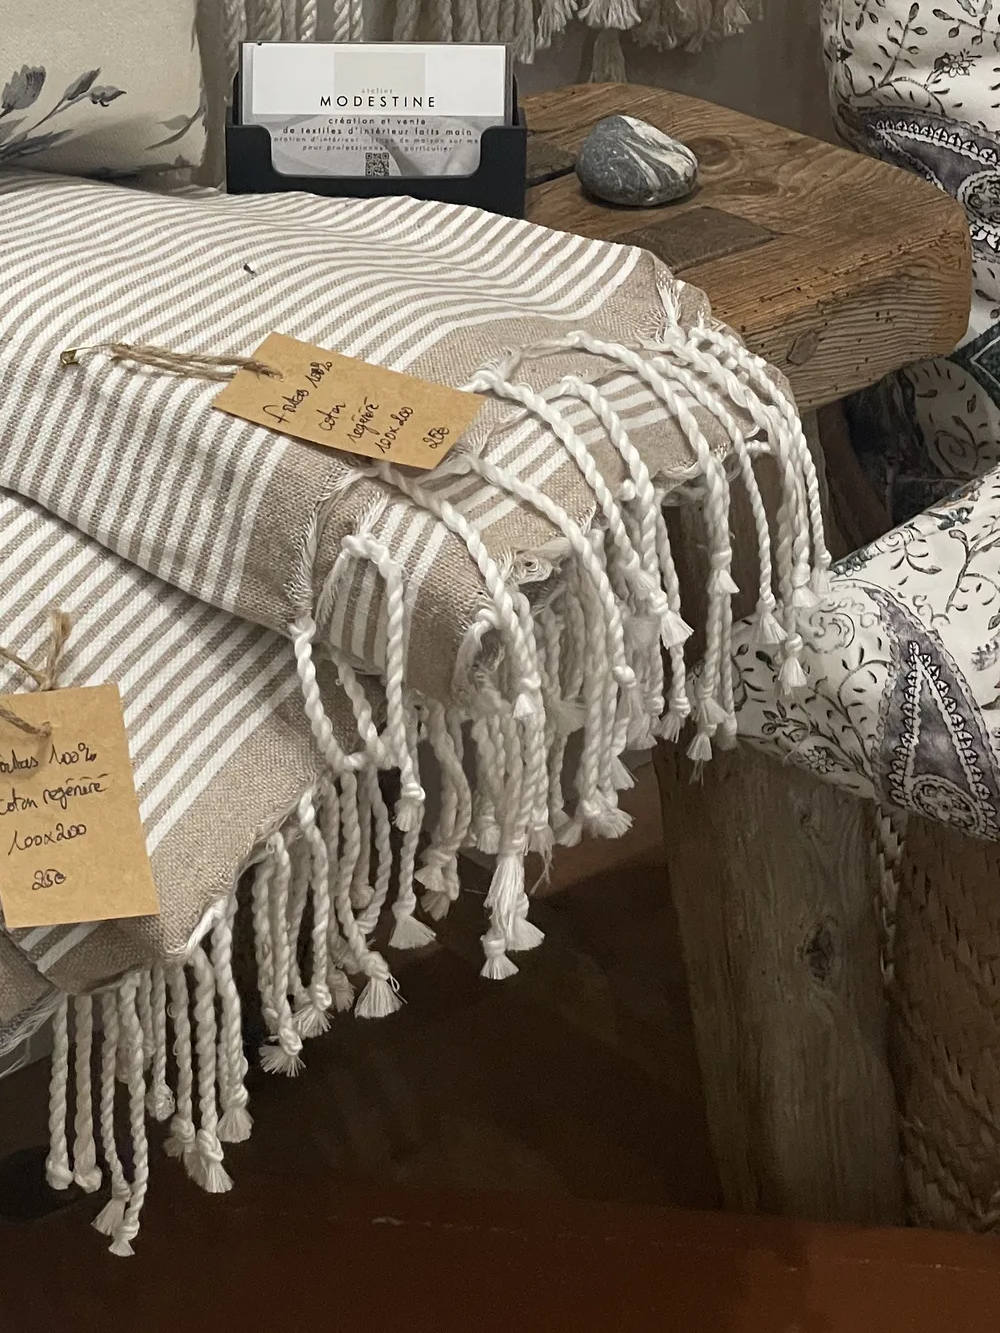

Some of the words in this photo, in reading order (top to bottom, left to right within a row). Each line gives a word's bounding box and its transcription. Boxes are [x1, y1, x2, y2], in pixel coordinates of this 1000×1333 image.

[320, 95, 435, 108] MODESTINE
[328, 117, 375, 125] création
[397, 118, 426, 126] vente
[283, 126, 295, 134] de
[301, 127, 342, 135] textiles
[415, 127, 440, 136] faits
[445, 128, 472, 137] main
